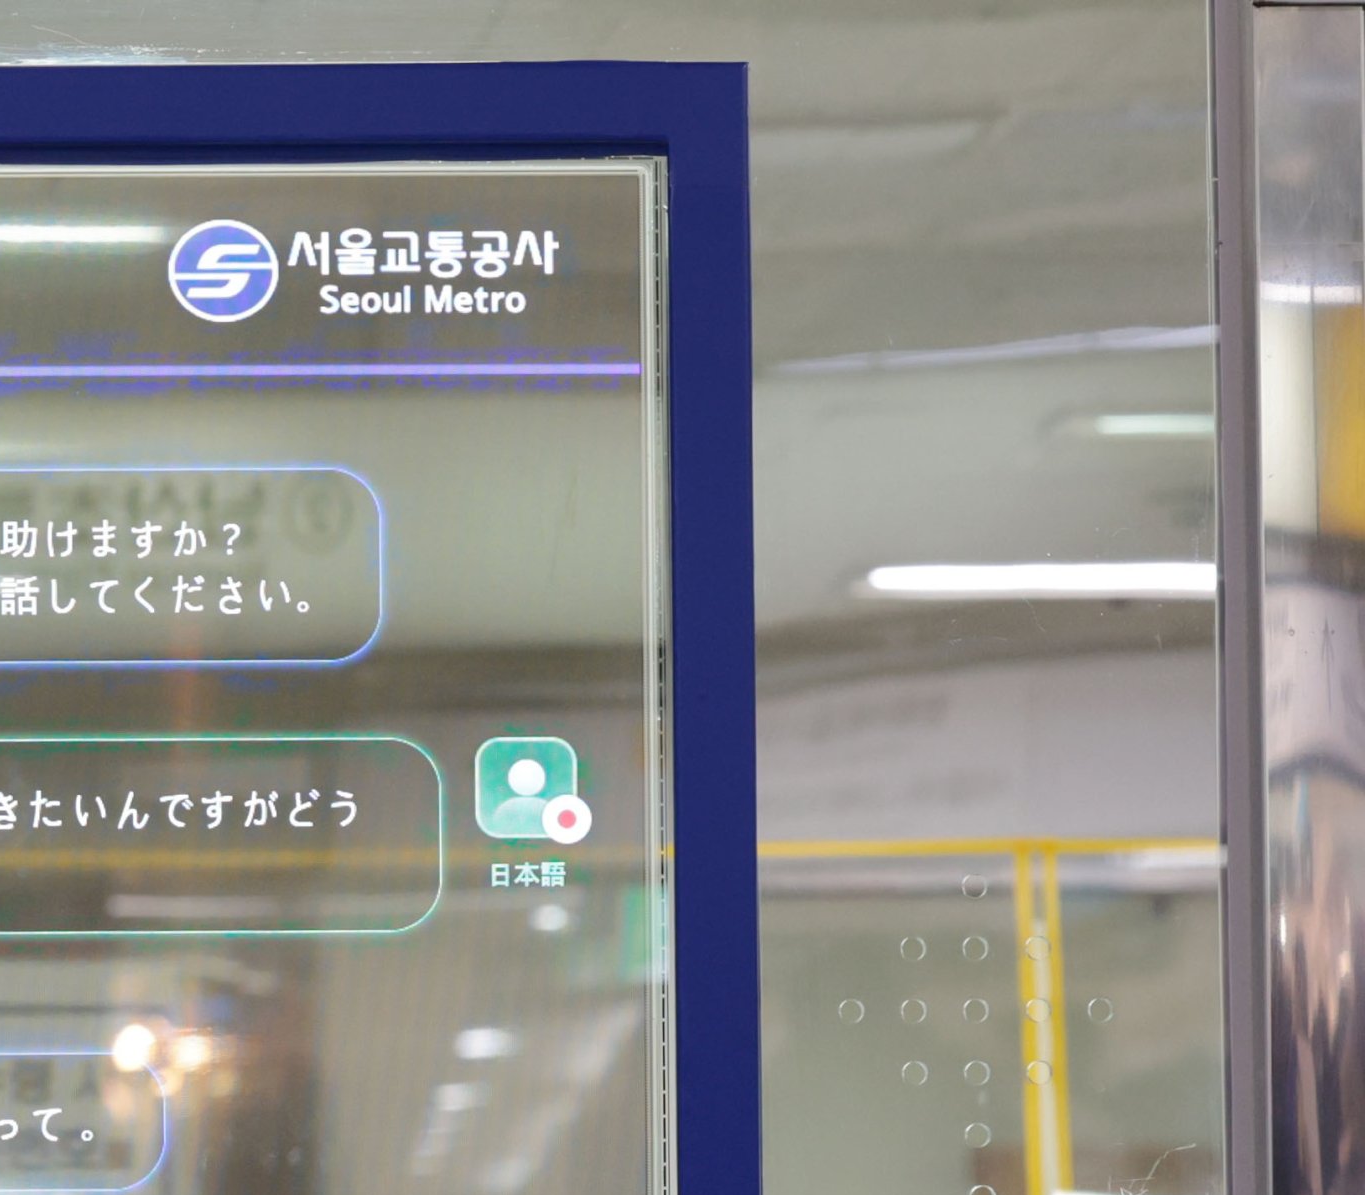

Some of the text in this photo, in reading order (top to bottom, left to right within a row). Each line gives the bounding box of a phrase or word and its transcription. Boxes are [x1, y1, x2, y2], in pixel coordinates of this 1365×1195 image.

[288, 228, 559, 278] 서울교통공사
[320, 285, 526, 313] Seoul Metro
[492, 862, 565, 886] 日本語
